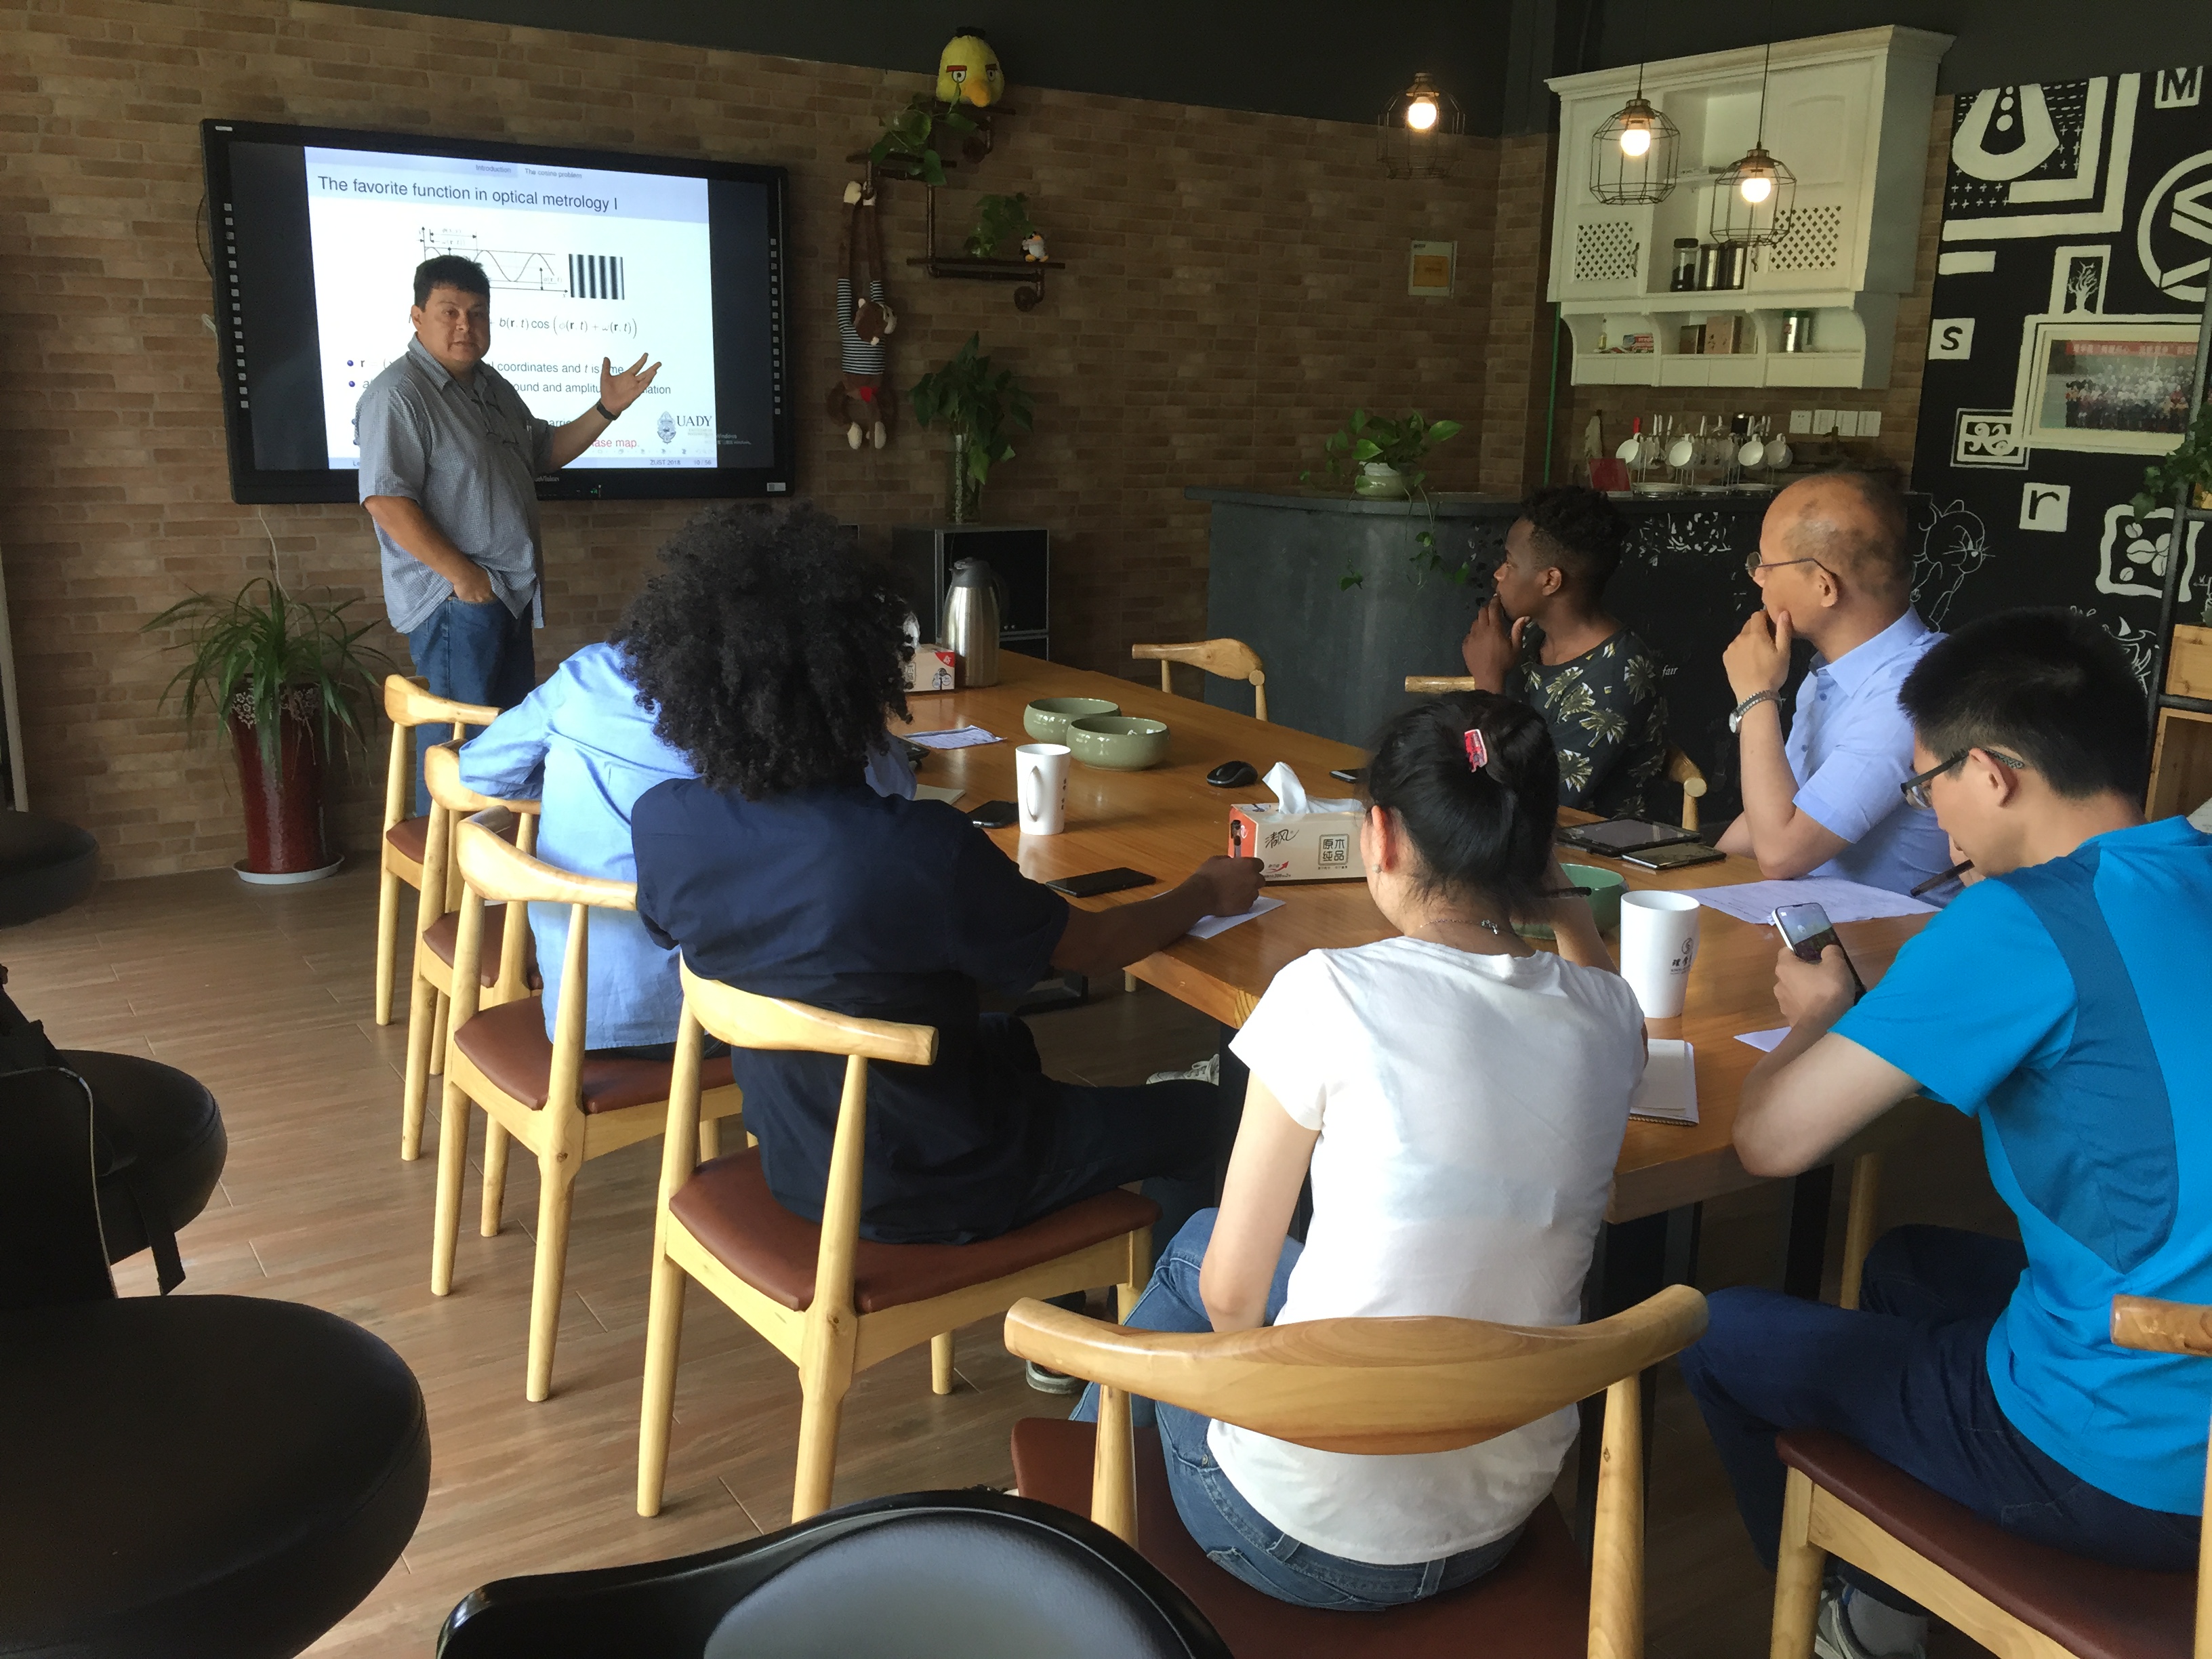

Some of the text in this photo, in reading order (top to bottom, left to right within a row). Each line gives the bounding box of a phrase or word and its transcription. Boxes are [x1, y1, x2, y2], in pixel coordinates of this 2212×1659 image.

[476, 164, 512, 173] Introduction
[525, 167, 536, 176] The
[558, 171, 582, 179] problem
[318, 176, 348, 192] The
[353, 178, 408, 195] favorite
[413, 183, 470, 200] function
[475, 187, 487, 201] in
[493, 190, 537, 205] optical
[543, 194, 609, 213] metrology
[531, 320, 550, 329] cos
[497, 362, 558, 373] coordinates
[562, 363, 581, 373] and
[591, 365, 600, 373] is
[542, 382, 562, 392] and
[565, 383, 601, 394] amplitu
[676, 415, 712, 427] UADY
[1662, 664, 1679, 678] fair
[1265, 828, 1299, 848] 清风
